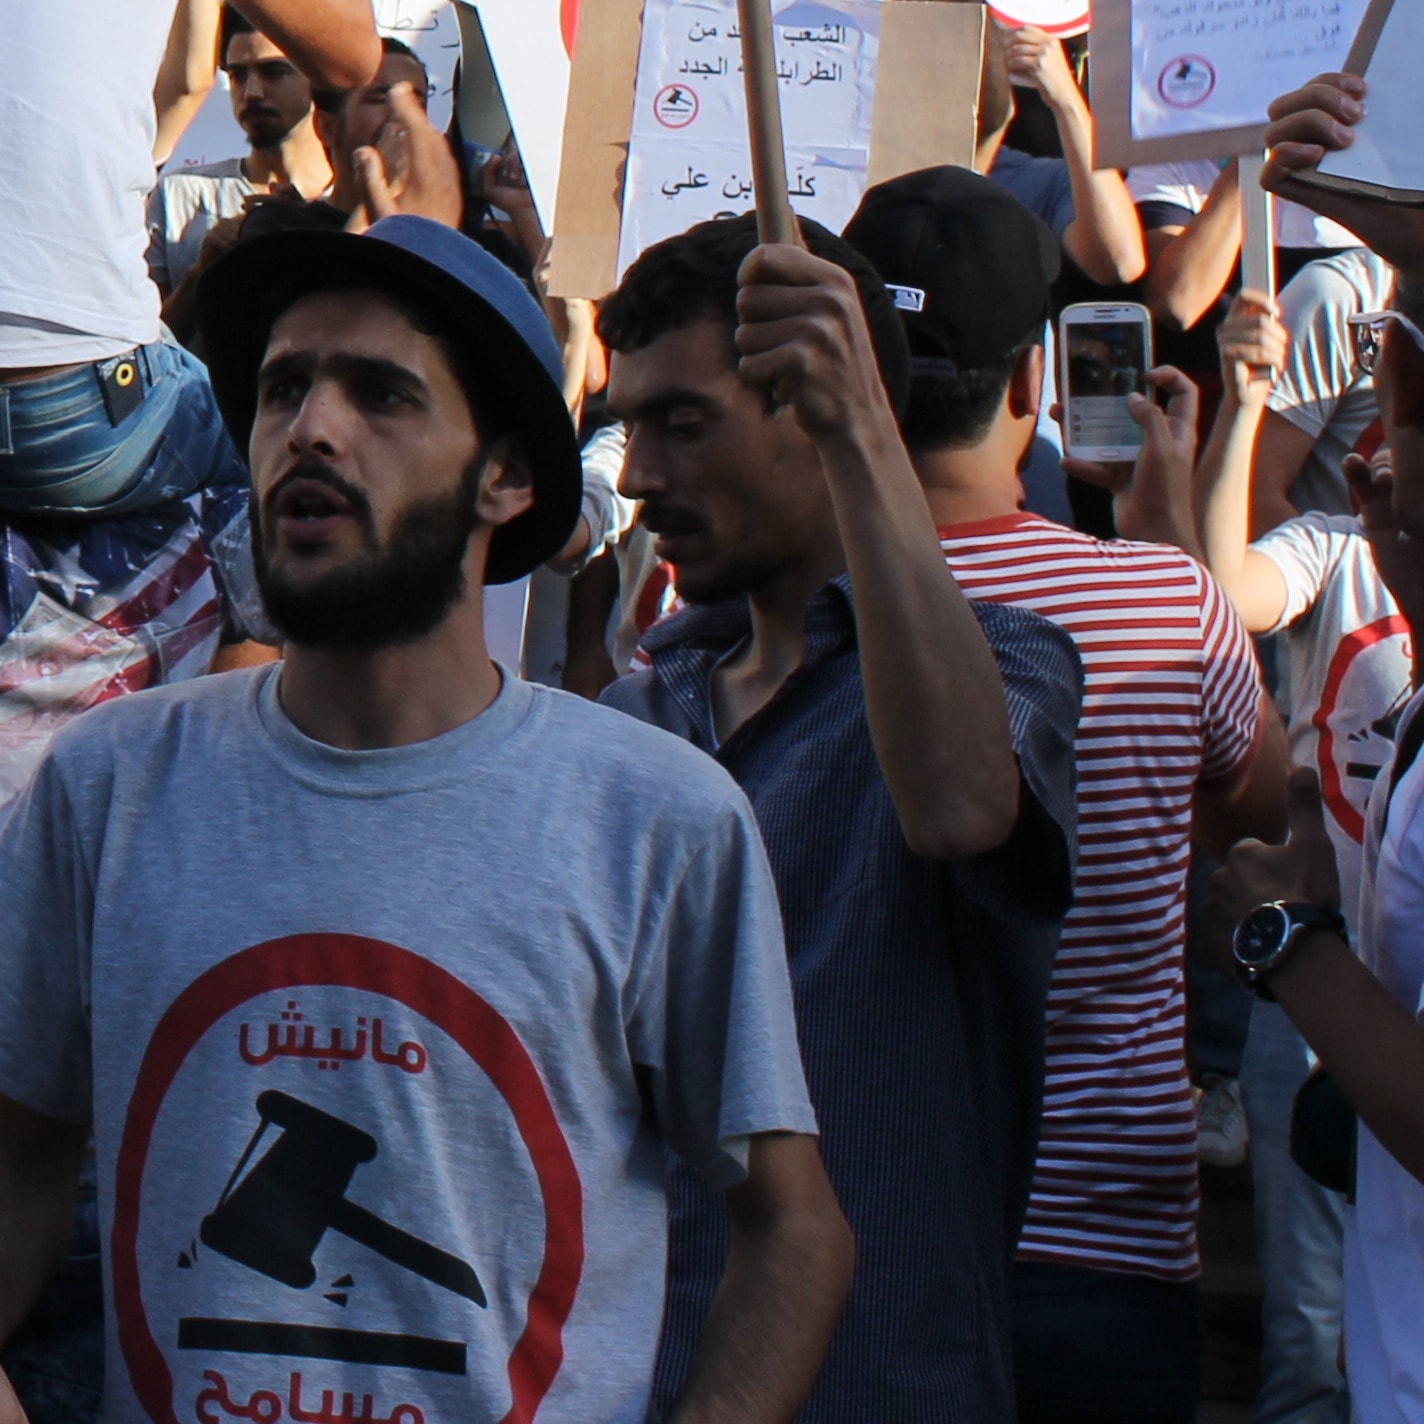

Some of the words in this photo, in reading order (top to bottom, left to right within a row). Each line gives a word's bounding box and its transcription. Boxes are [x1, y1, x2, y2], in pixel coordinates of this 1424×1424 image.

[688, 22, 717, 42] من
[782, 23, 847, 47] الشعب
[679, 56, 728, 80] الجدد
[661, 165, 709, 200] علي
[722, 175, 754, 200] بن
[238, 1000, 428, 1074] مانيش
